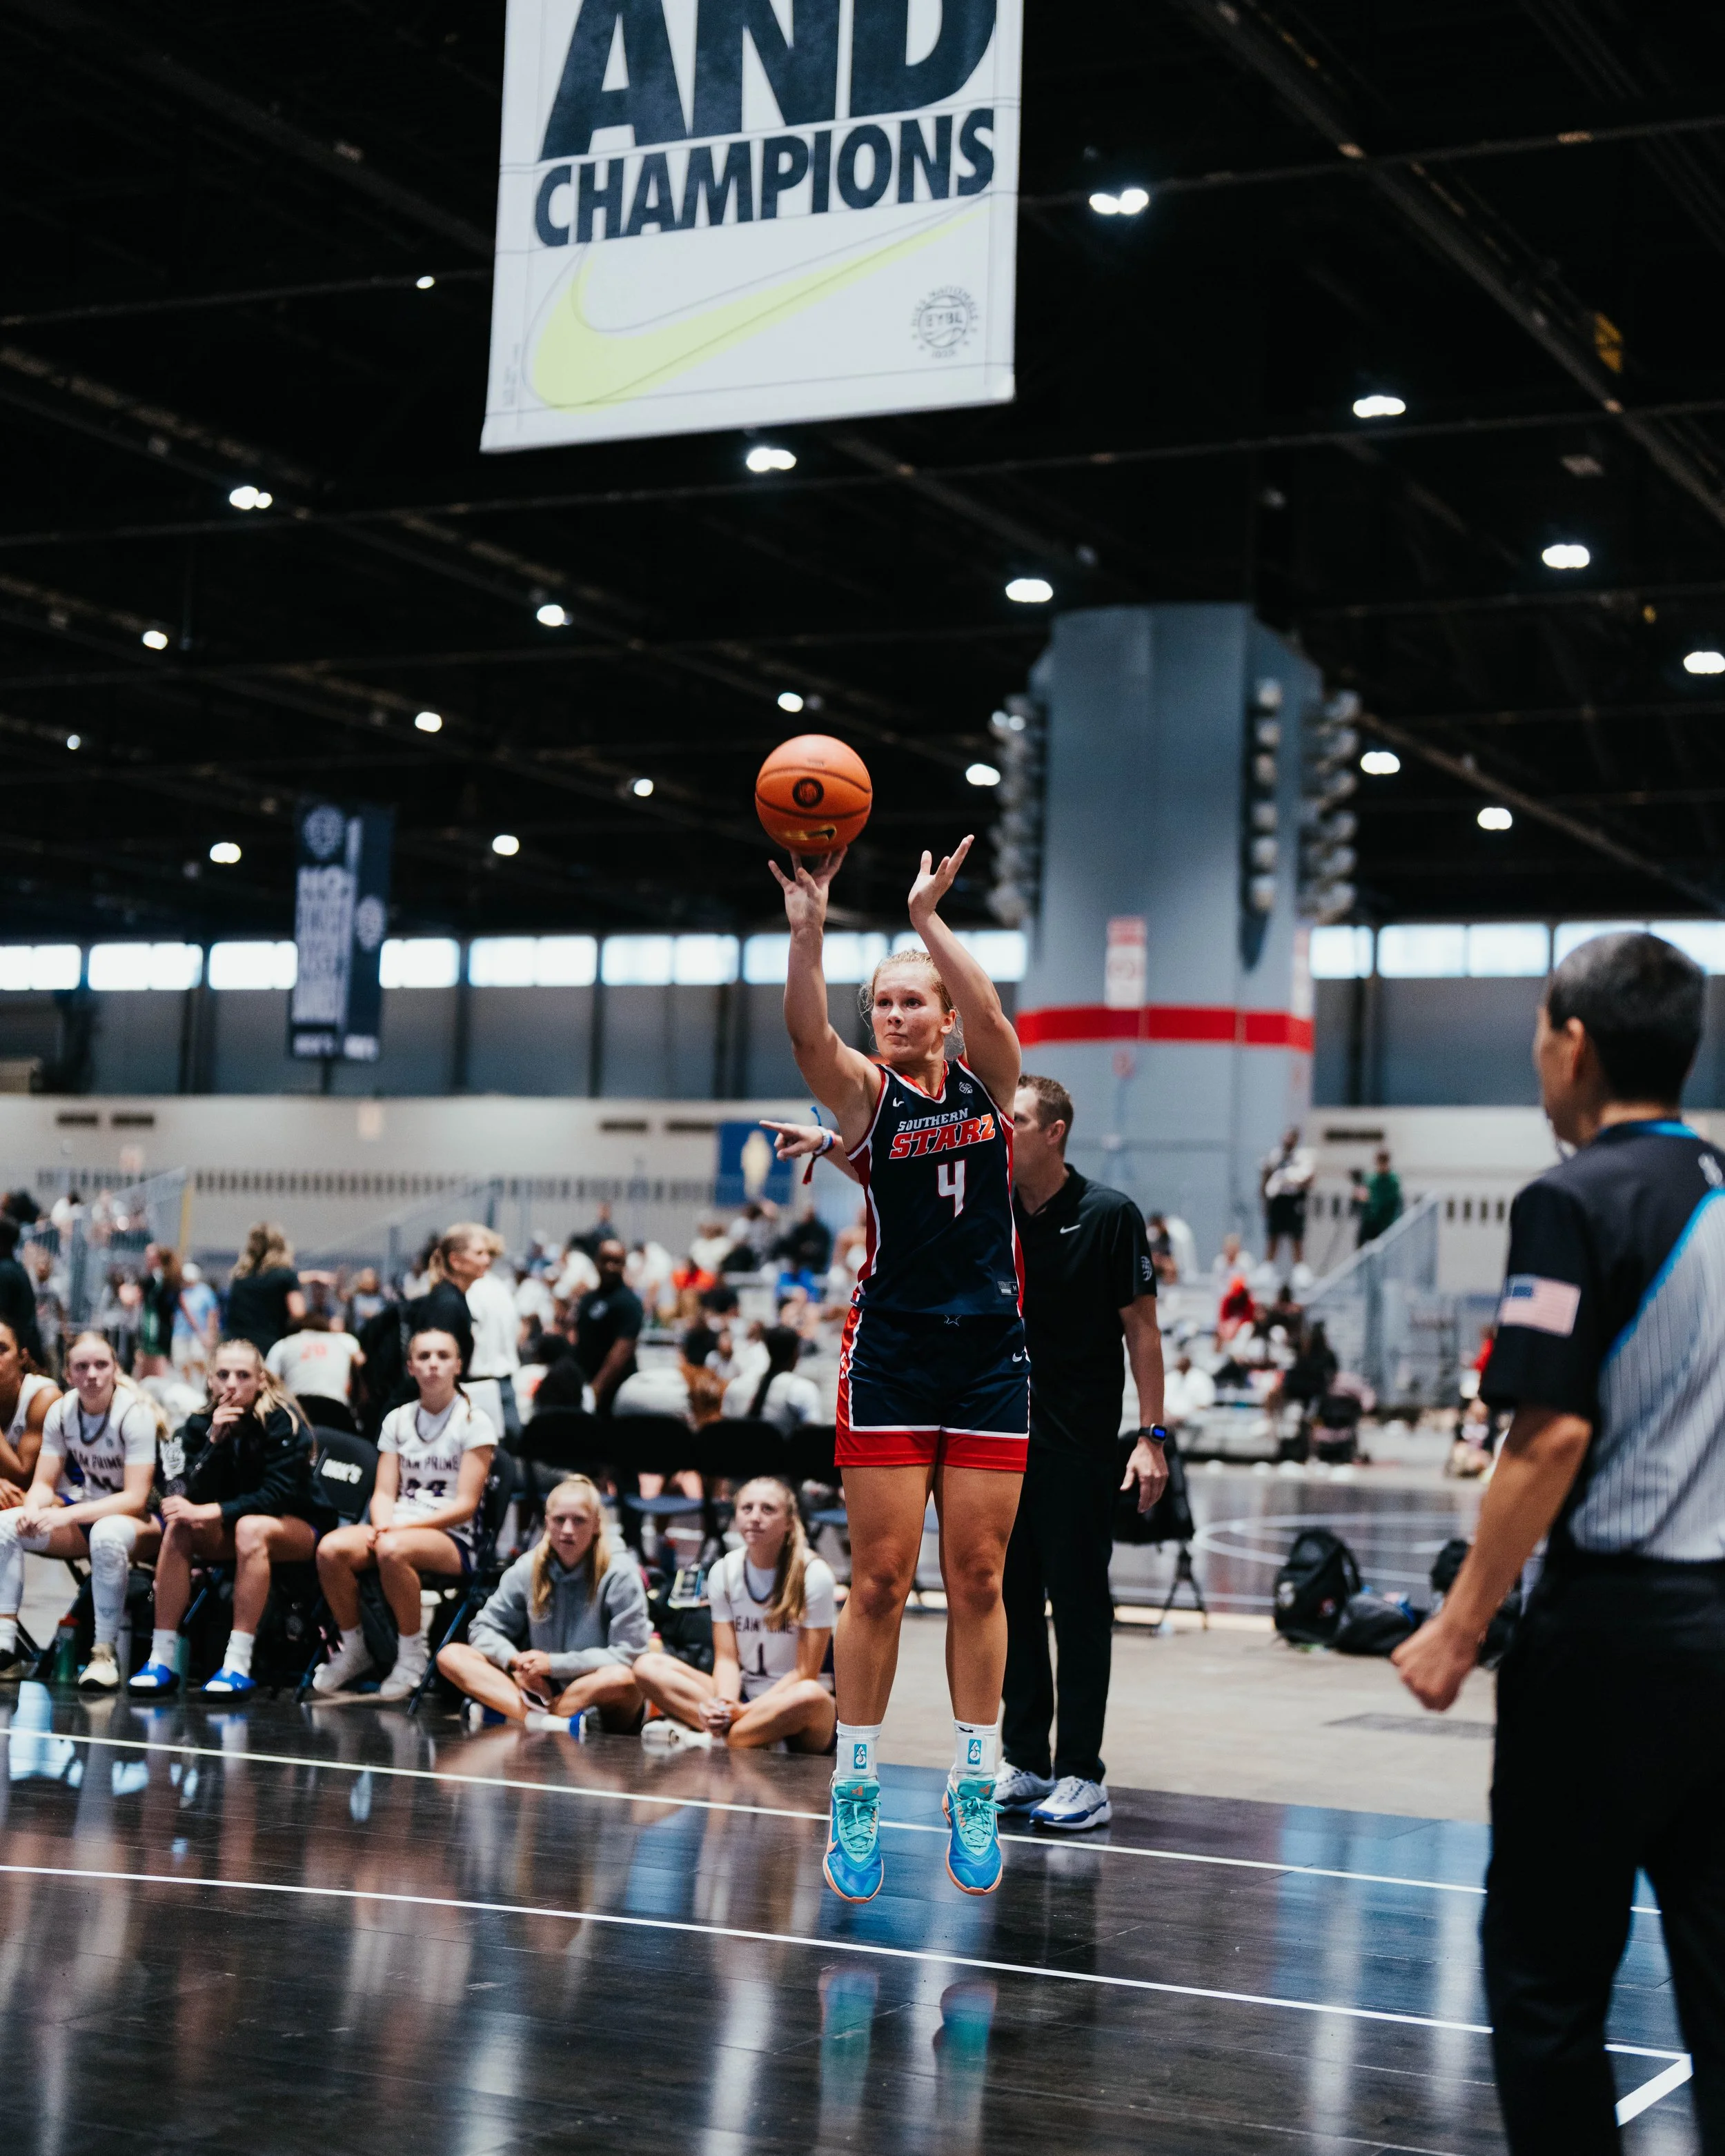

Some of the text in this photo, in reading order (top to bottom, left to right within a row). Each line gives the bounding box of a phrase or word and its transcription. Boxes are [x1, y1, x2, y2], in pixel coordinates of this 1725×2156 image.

[538, 0, 996, 163] AND
[534, 108, 994, 247] CHAMPIONS
[889, 1114, 996, 1159] STARZ
[897, 1107, 968, 1131] SOUTHERN
[938, 1159, 965, 1218] 4
